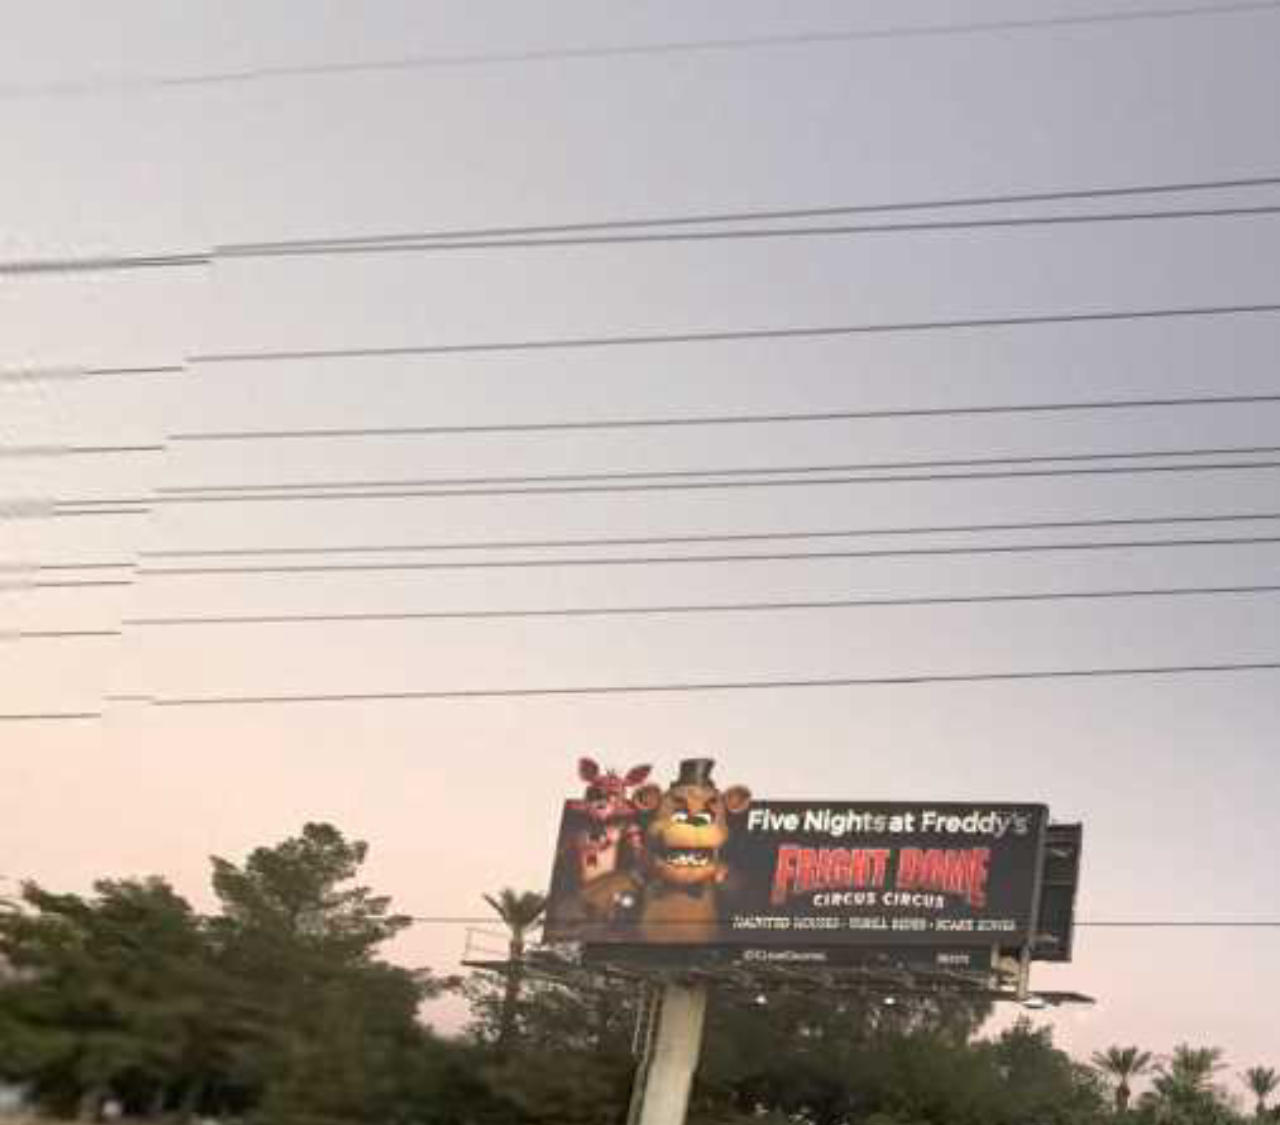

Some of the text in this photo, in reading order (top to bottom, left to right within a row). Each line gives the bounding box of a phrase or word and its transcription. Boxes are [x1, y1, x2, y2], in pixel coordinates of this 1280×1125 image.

[747, 808, 1028, 838] Five Nights at Freddy's
[768, 846, 991, 907] FRIGHT DOME
[812, 891, 945, 909] CIRCUS CIRCUS
